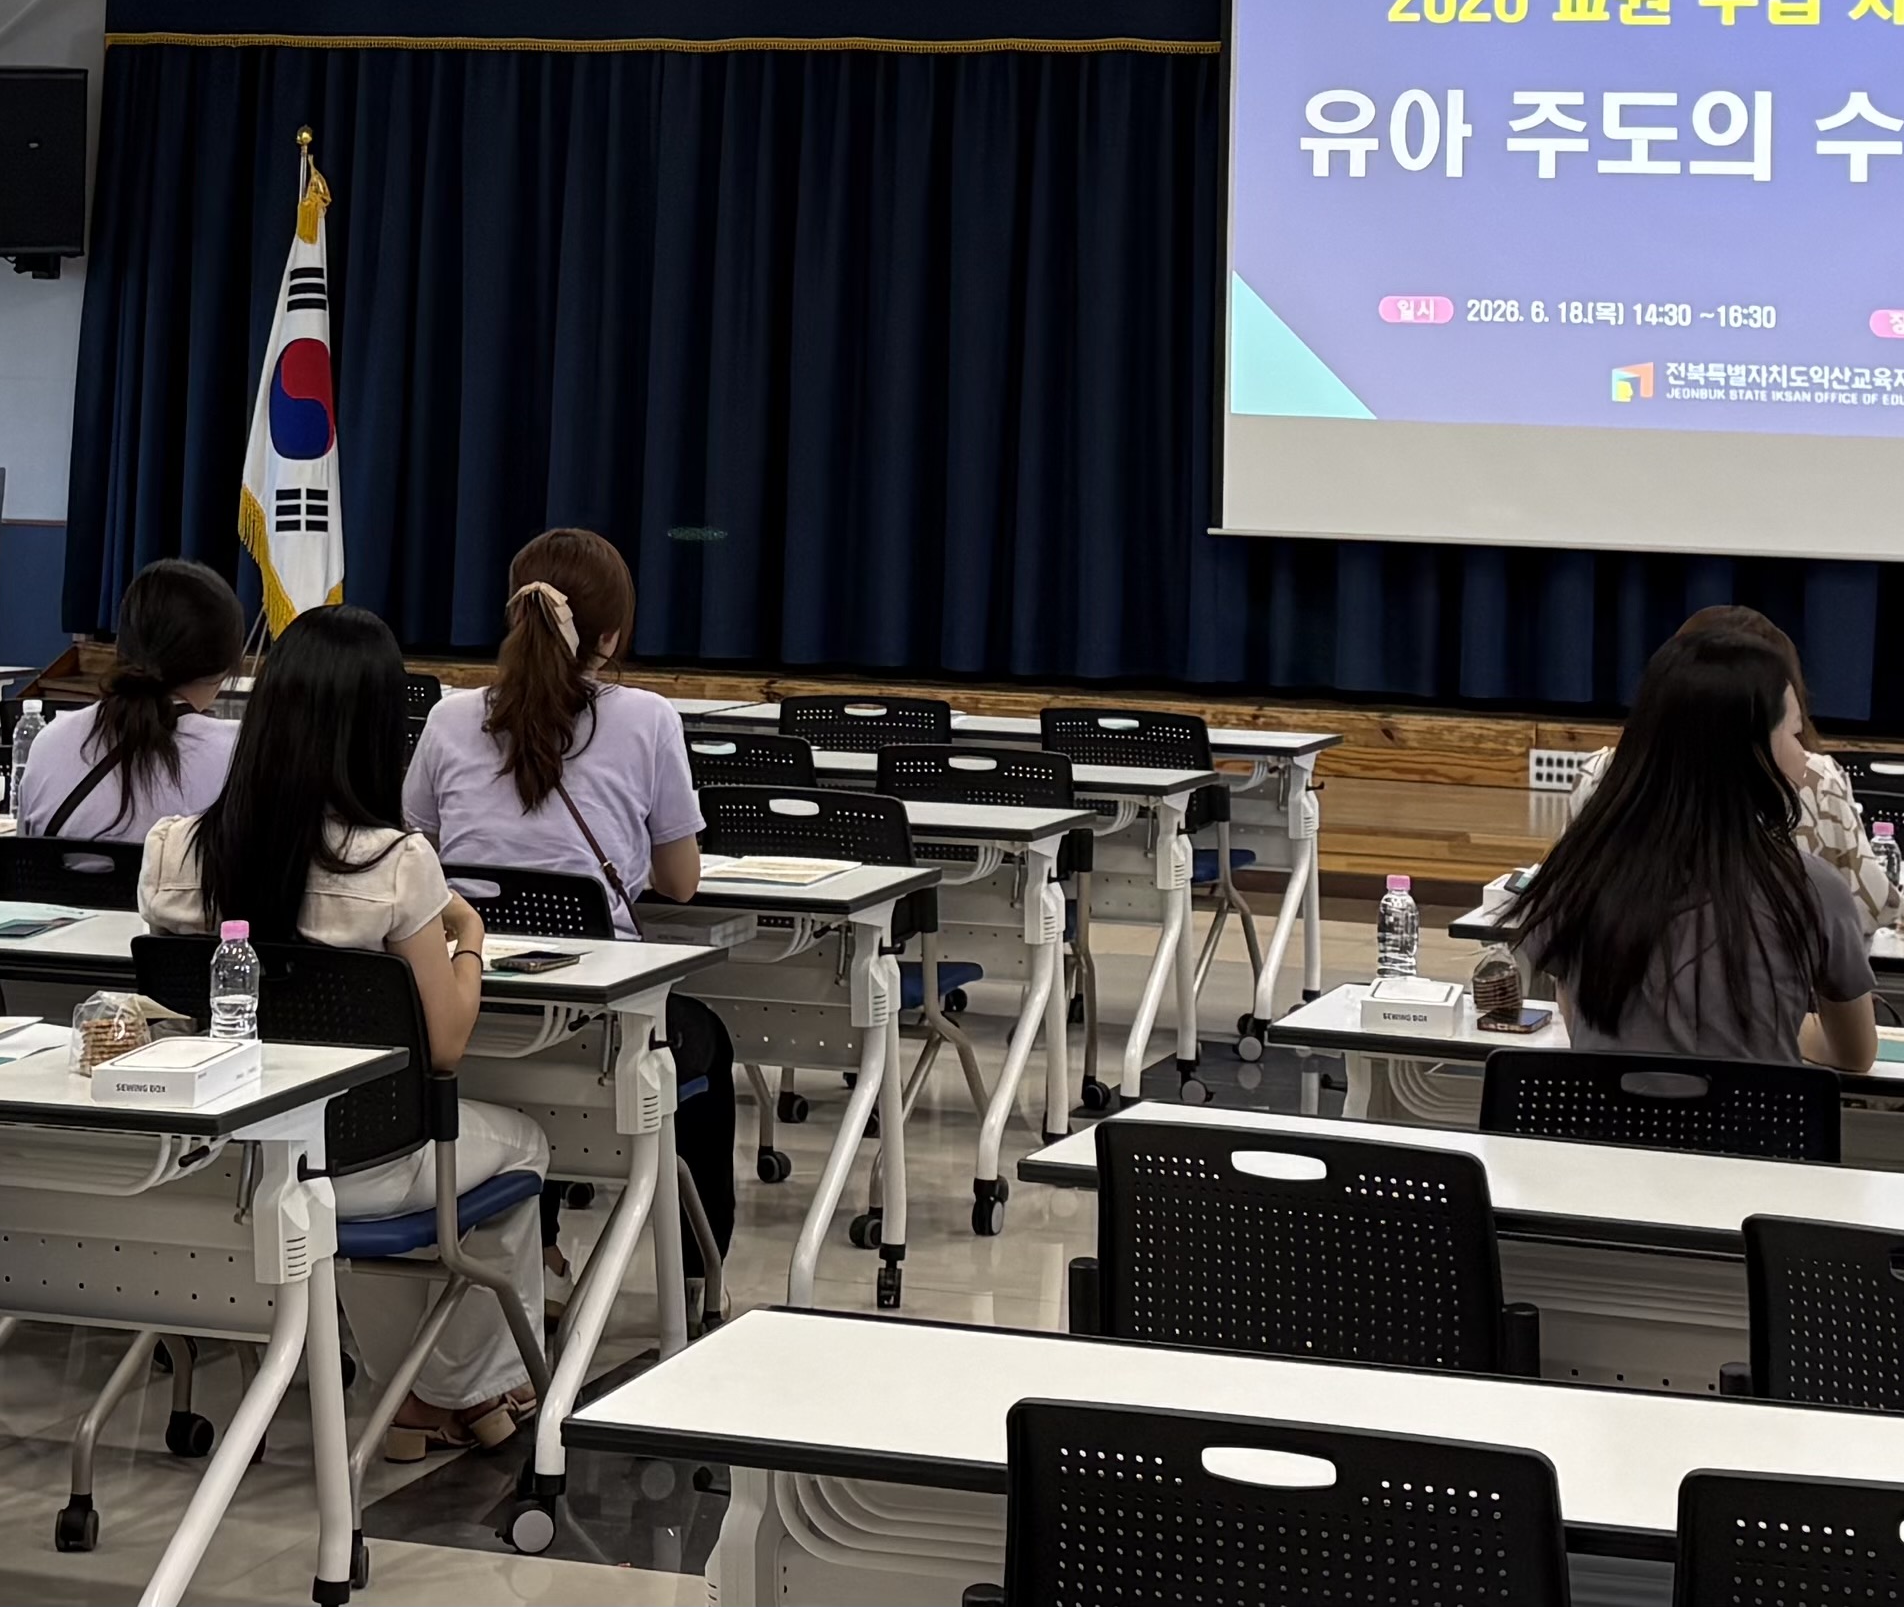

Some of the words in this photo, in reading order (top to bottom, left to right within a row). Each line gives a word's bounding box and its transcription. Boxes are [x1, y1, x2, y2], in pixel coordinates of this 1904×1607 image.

[1299, 87, 1474, 180] 유아
[1505, 89, 1773, 183] 주도의
[1396, 299, 1436, 322] 일시
[1466, 299, 1525, 324] 2026.
[1530, 300, 1550, 324] 6.
[1632, 302, 1692, 328] 14:30
[1698, 304, 1778, 329] ~16:30
[1666, 387, 1726, 401] JEONBUK
[1729, 388, 1768, 402] STATE
[1771, 390, 1812, 404] IKSAN
[1814, 391, 1858, 405] OFFICE
[1862, 392, 1881, 406] OF
[116, 1082, 147, 1093] SEWING
[149, 1084, 166, 1094] BOX
